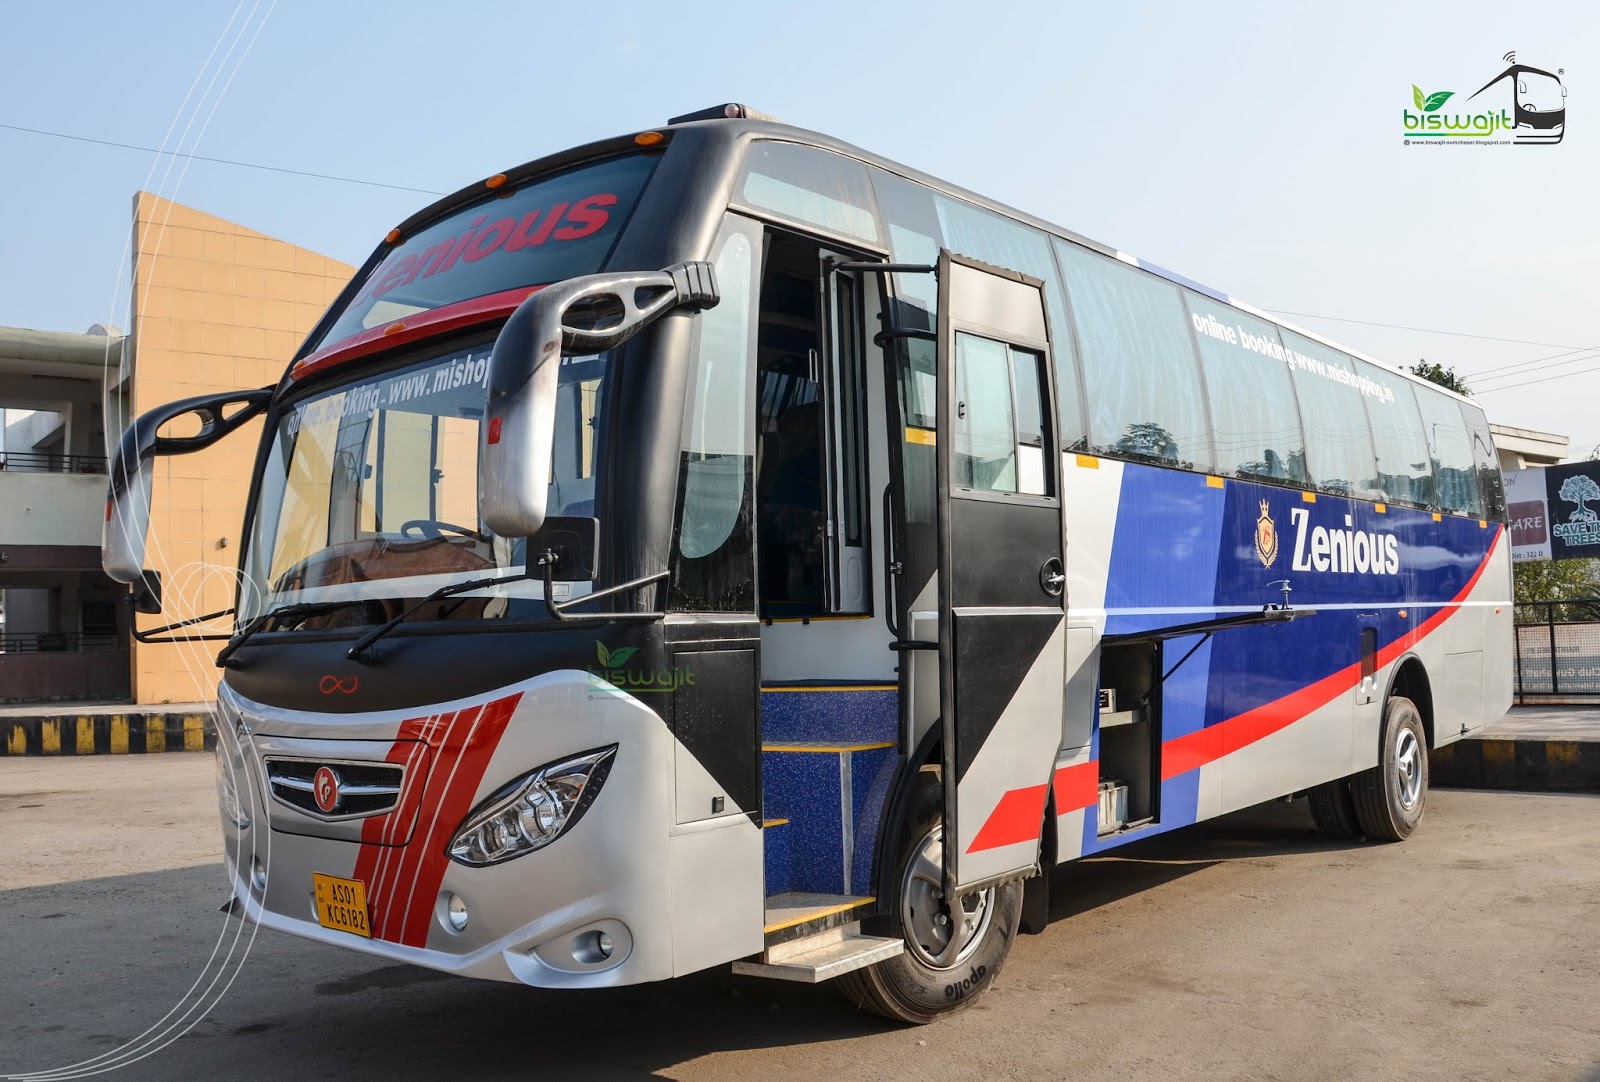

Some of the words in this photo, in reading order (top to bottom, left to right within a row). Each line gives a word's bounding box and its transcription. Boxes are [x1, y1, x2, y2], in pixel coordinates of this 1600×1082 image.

[1192, 312, 1238, 345] online
[1290, 507, 1400, 575] Zenious
[1553, 522, 1588, 537] SAVE
[332, 883, 357, 906] AS01
[327, 903, 366, 930] KC6182
[944, 964, 987, 1001] apollo
